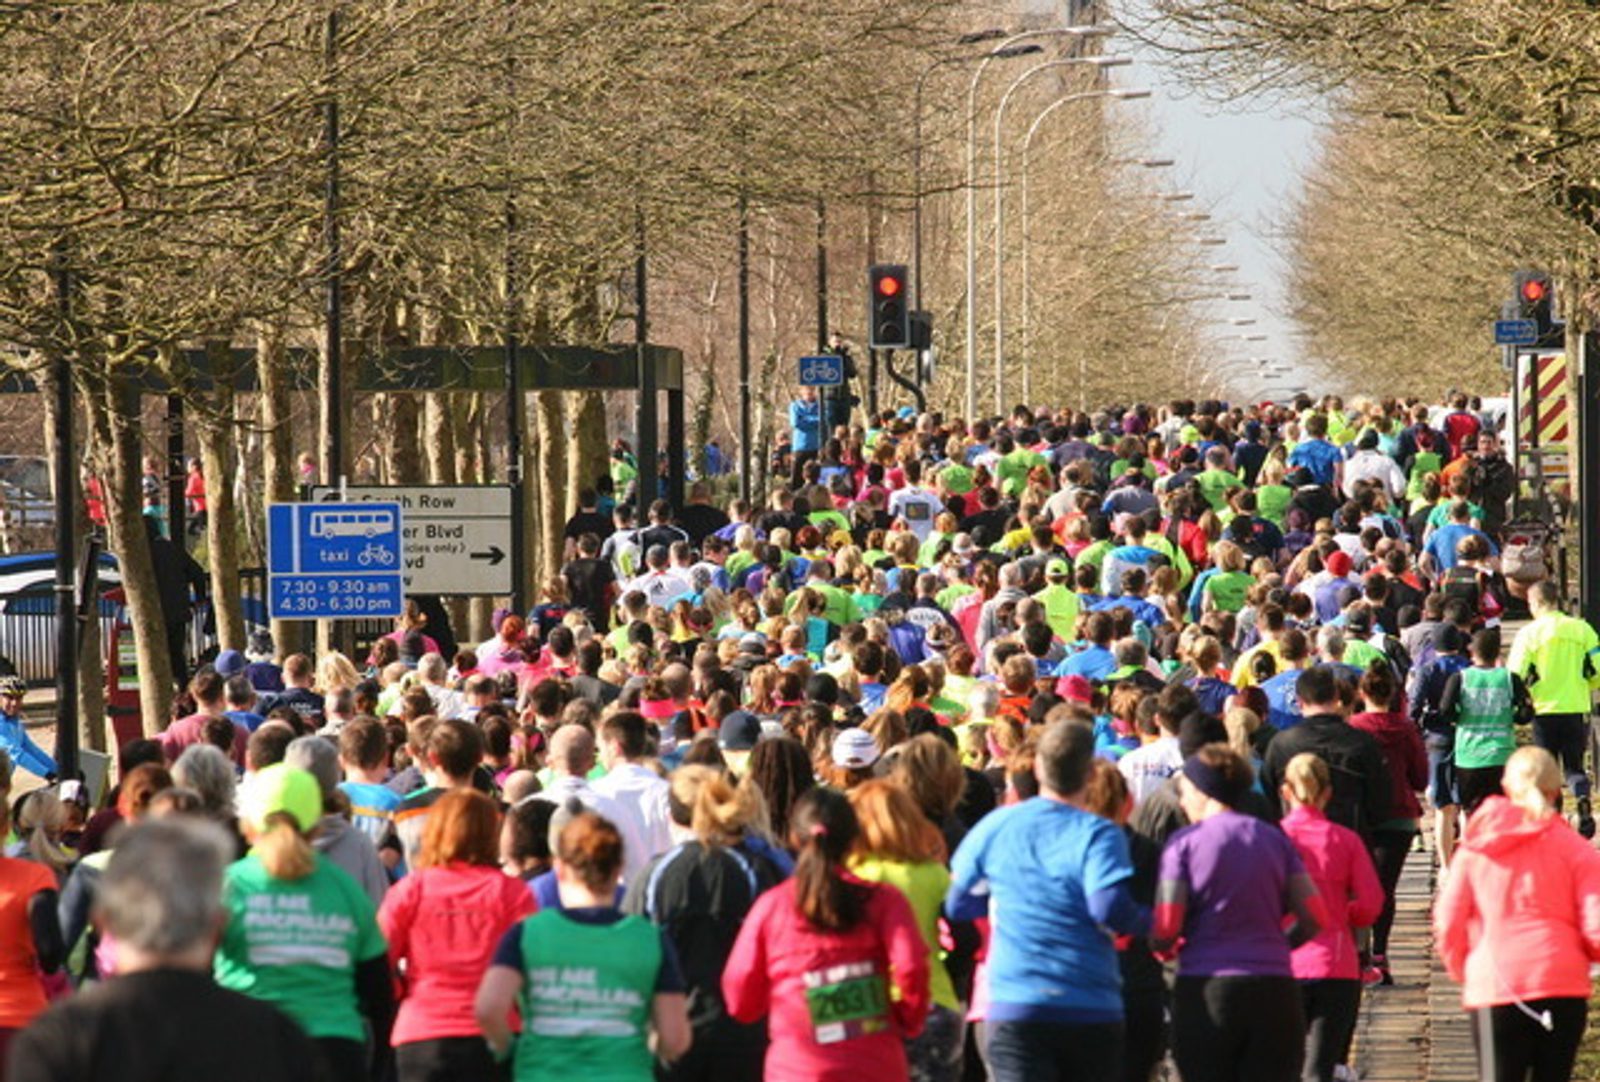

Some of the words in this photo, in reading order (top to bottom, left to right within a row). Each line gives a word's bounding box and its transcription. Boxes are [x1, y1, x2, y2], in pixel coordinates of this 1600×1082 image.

[419, 495, 455, 508] Row
[426, 525, 463, 538] Blvd
[319, 549, 349, 562] taxi
[281, 580, 317, 594] 7.30
[327, 580, 364, 593] 9.30
[367, 582, 390, 593] am
[280, 597, 318, 611] 4.30
[329, 596, 365, 610] 6.30
[367, 599, 391, 611] pm
